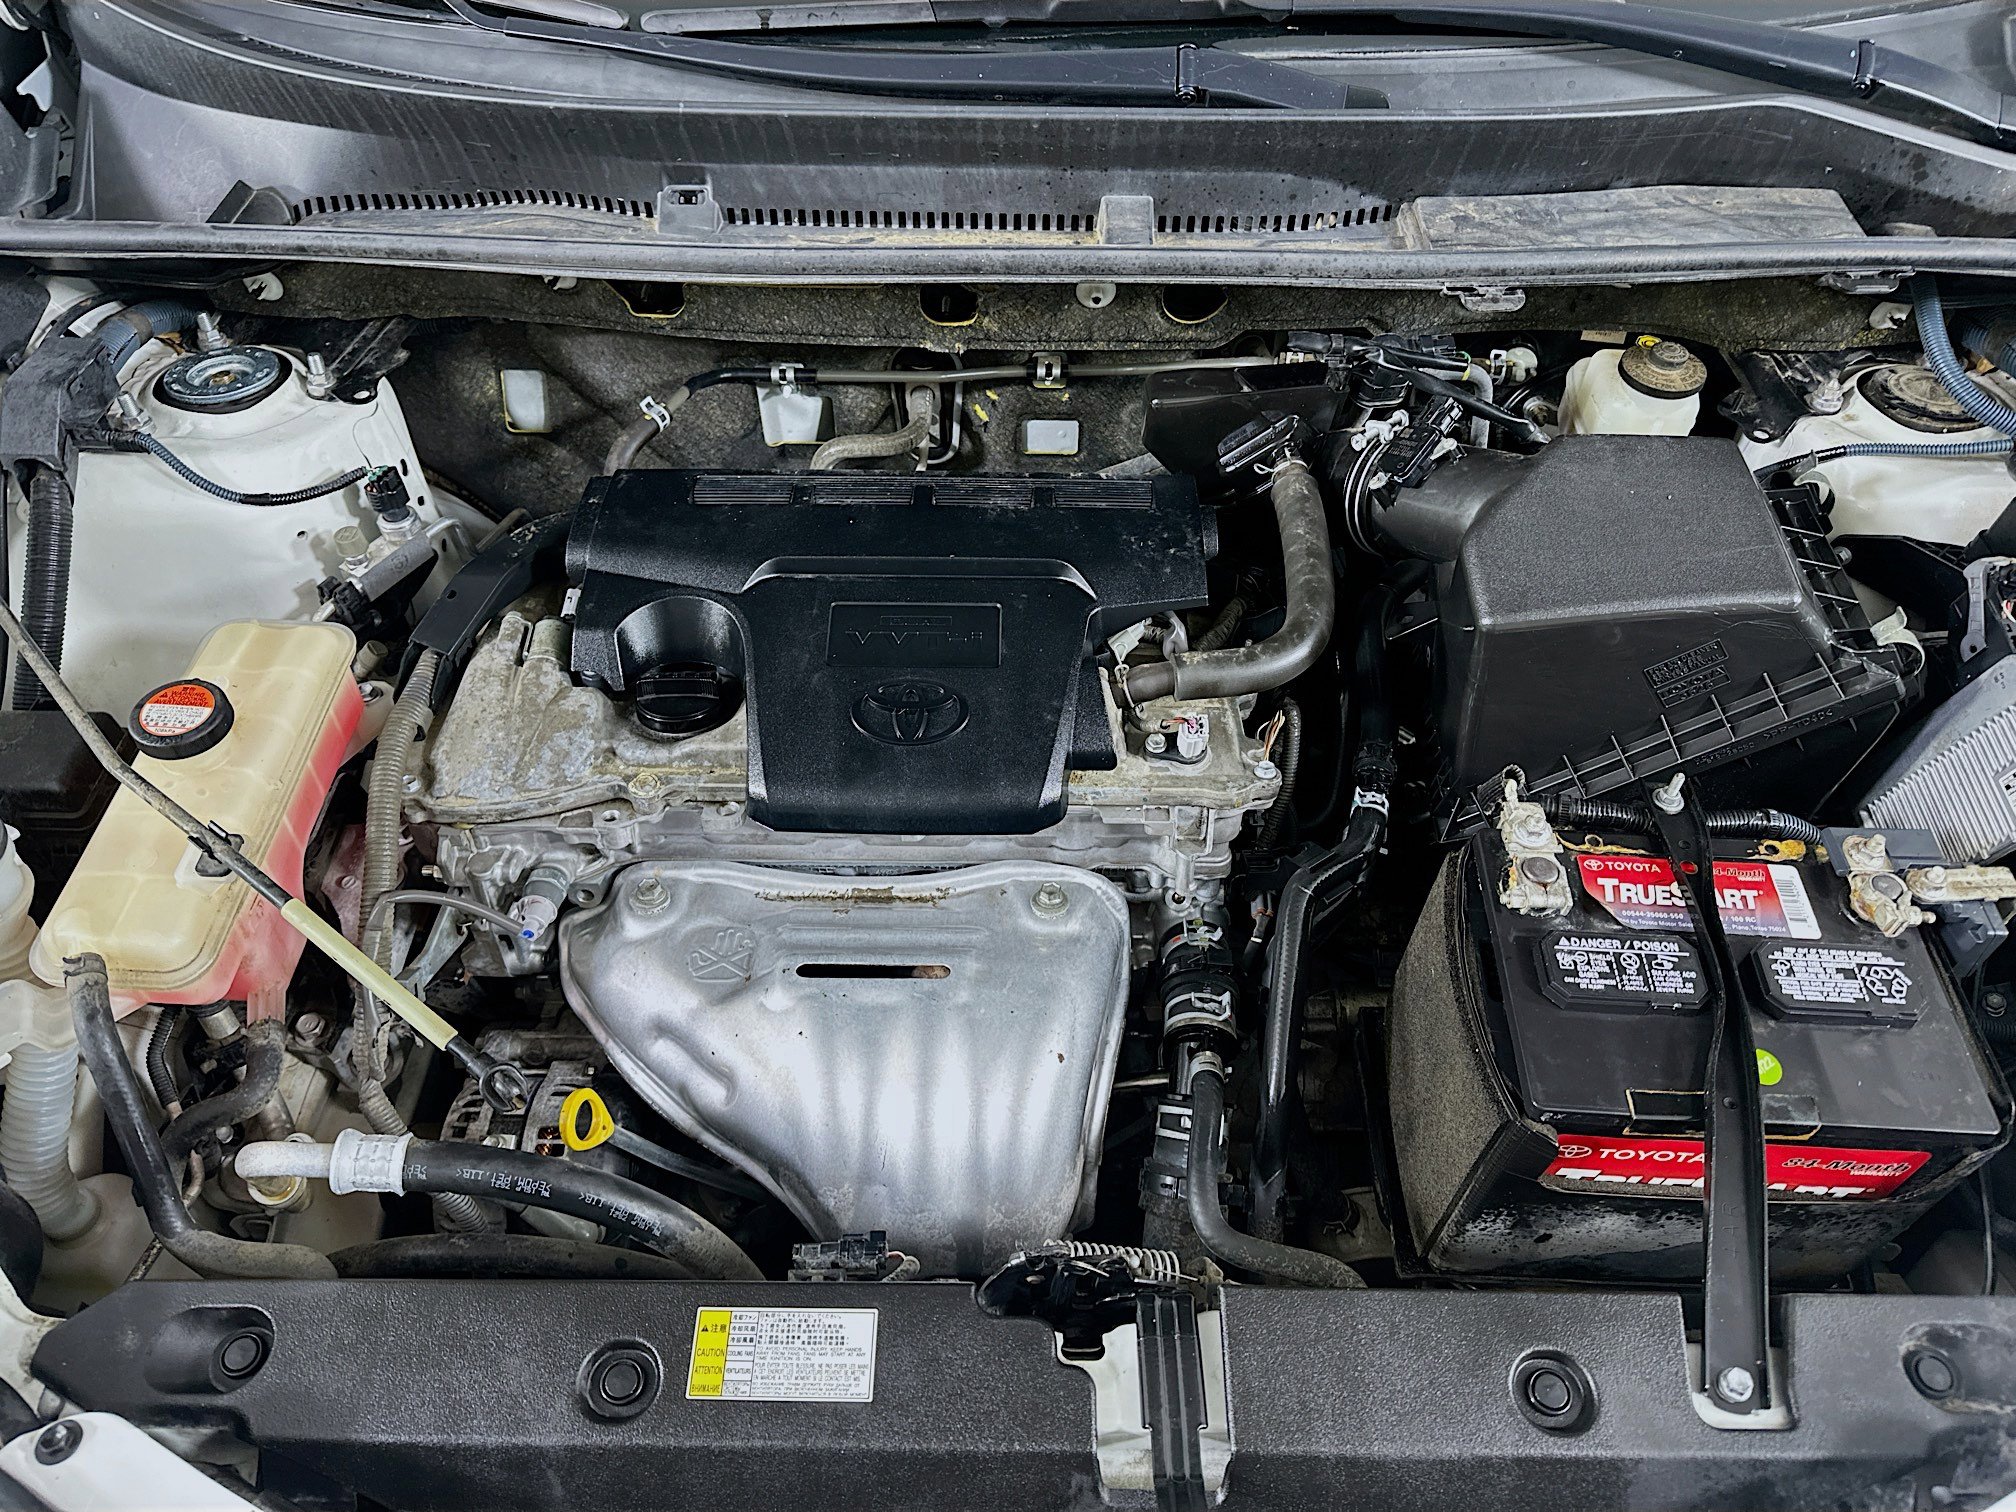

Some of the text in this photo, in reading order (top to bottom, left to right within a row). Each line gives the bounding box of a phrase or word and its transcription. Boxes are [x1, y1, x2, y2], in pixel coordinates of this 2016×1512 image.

[1605, 861, 1765, 878] TOYOTA 4-Month
[1570, 937, 1622, 949] DANGER
[1633, 941, 1679, 952] POISON
[1599, 1148, 1912, 1173] TOYOTA 84-Month
[711, 1323, 727, 1334] 注意
[696, 1348, 725, 1357] CAUTION
[695, 1365, 723, 1375] ATTENTION
[691, 1383, 721, 1393] ВНИМАНИЕ
